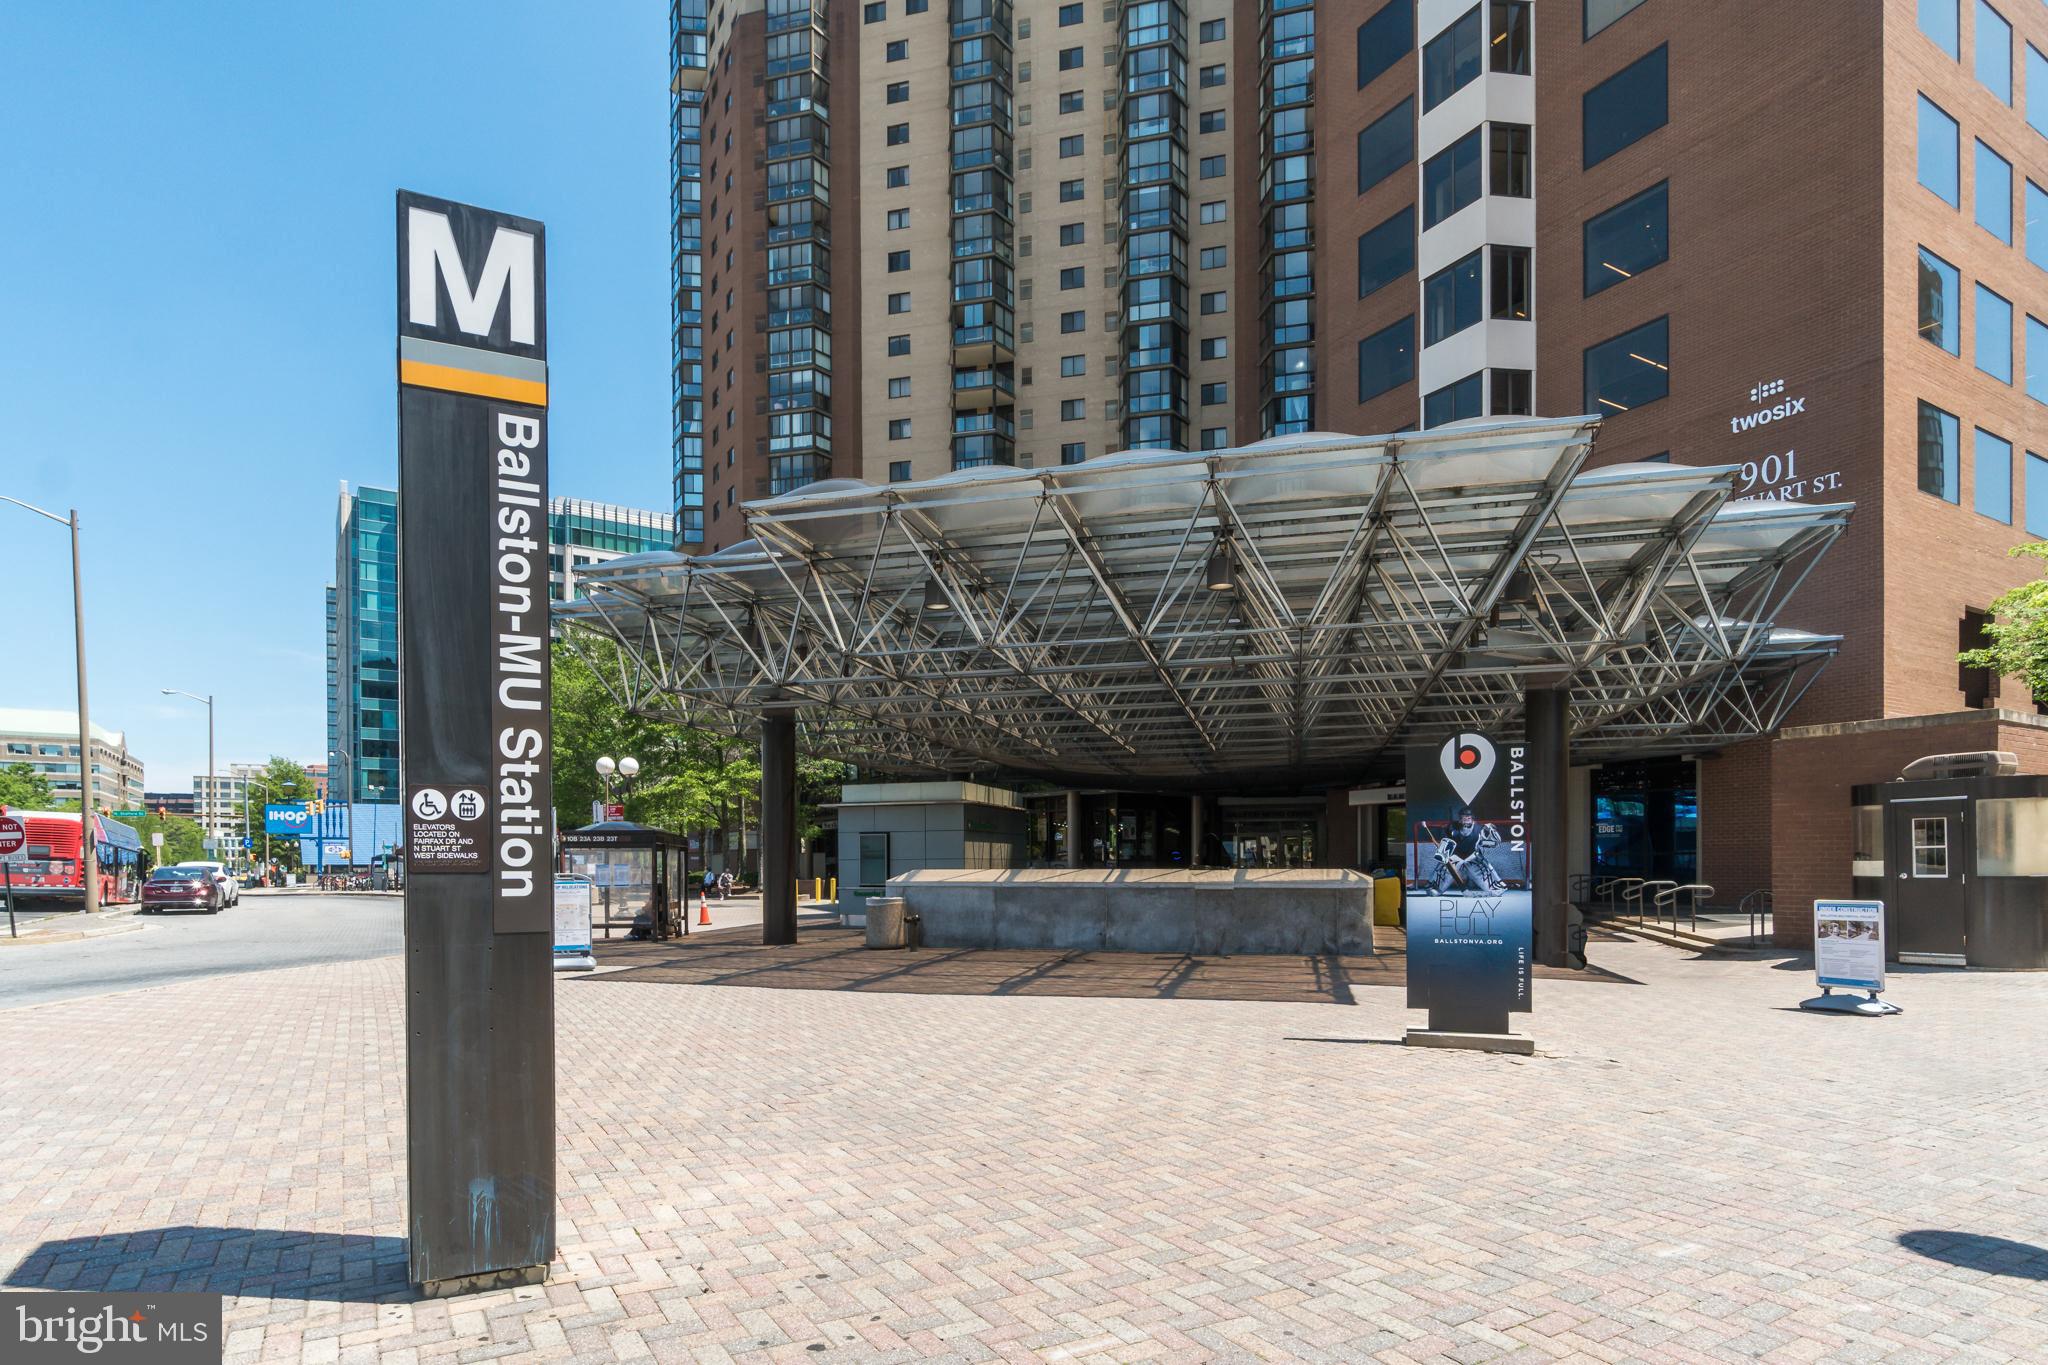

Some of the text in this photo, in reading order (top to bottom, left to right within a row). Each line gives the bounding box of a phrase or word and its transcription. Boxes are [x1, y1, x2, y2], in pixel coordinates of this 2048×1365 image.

[408, 206, 535, 345] M
[1730, 397, 1806, 433] twosix
[1740, 449, 1797, 493] 901
[1813, 471, 1843, 494] ST.
[497, 412, 543, 897] Ballston-MU Station
[1510, 747, 1525, 852] BALLSTON
[2, 823, 18, 831] NOT
[1440, 899, 1502, 918] PLAY
[1440, 917, 1502, 936] FULL
[1518, 967, 1525, 975] IS
